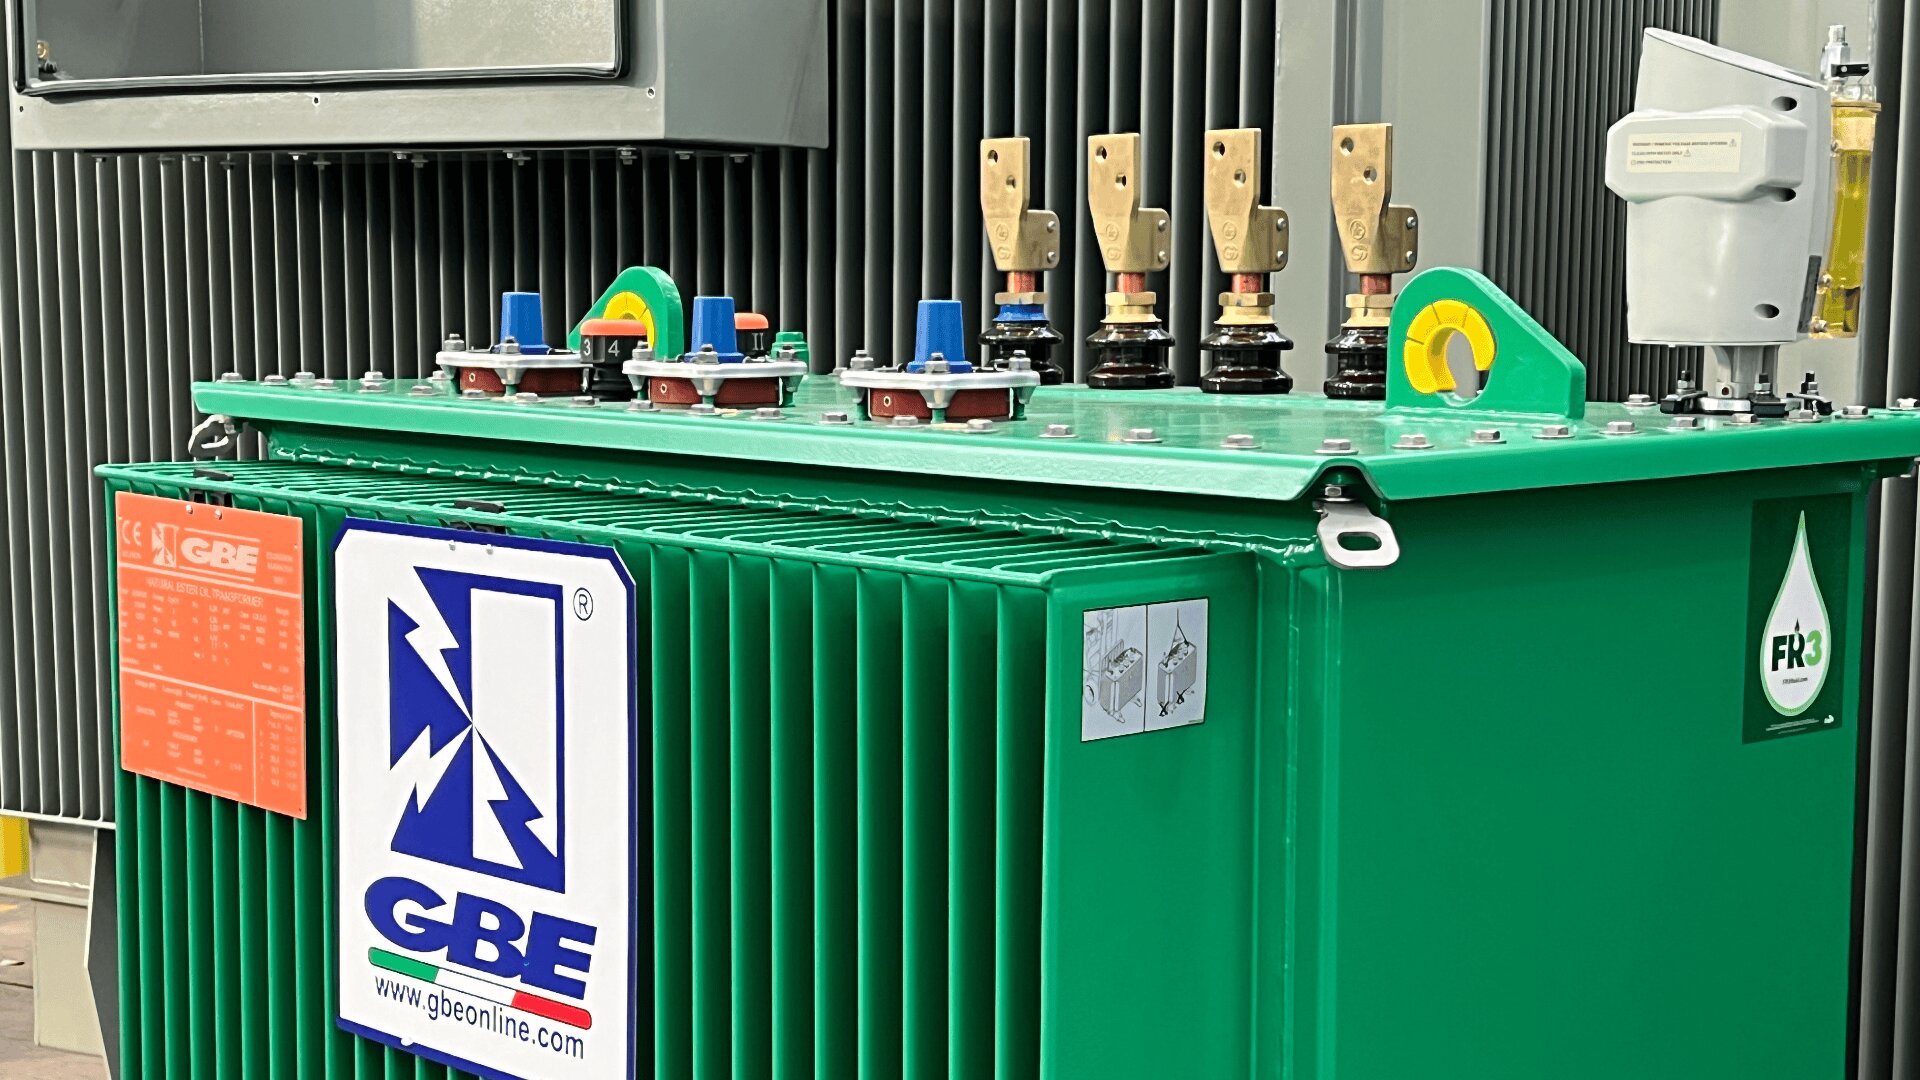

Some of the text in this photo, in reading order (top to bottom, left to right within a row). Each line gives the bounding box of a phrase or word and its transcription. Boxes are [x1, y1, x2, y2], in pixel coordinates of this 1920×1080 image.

[582, 339, 621, 357] 3 4
[180, 537, 260, 574] GBE
[175, 581, 199, 596] ESTER
[211, 587, 264, 608] TRANSFORMER
[1771, 629, 1823, 672] FR3
[364, 876, 598, 1000] GBE
[374, 975, 585, 1060] www.gbeonline.com
